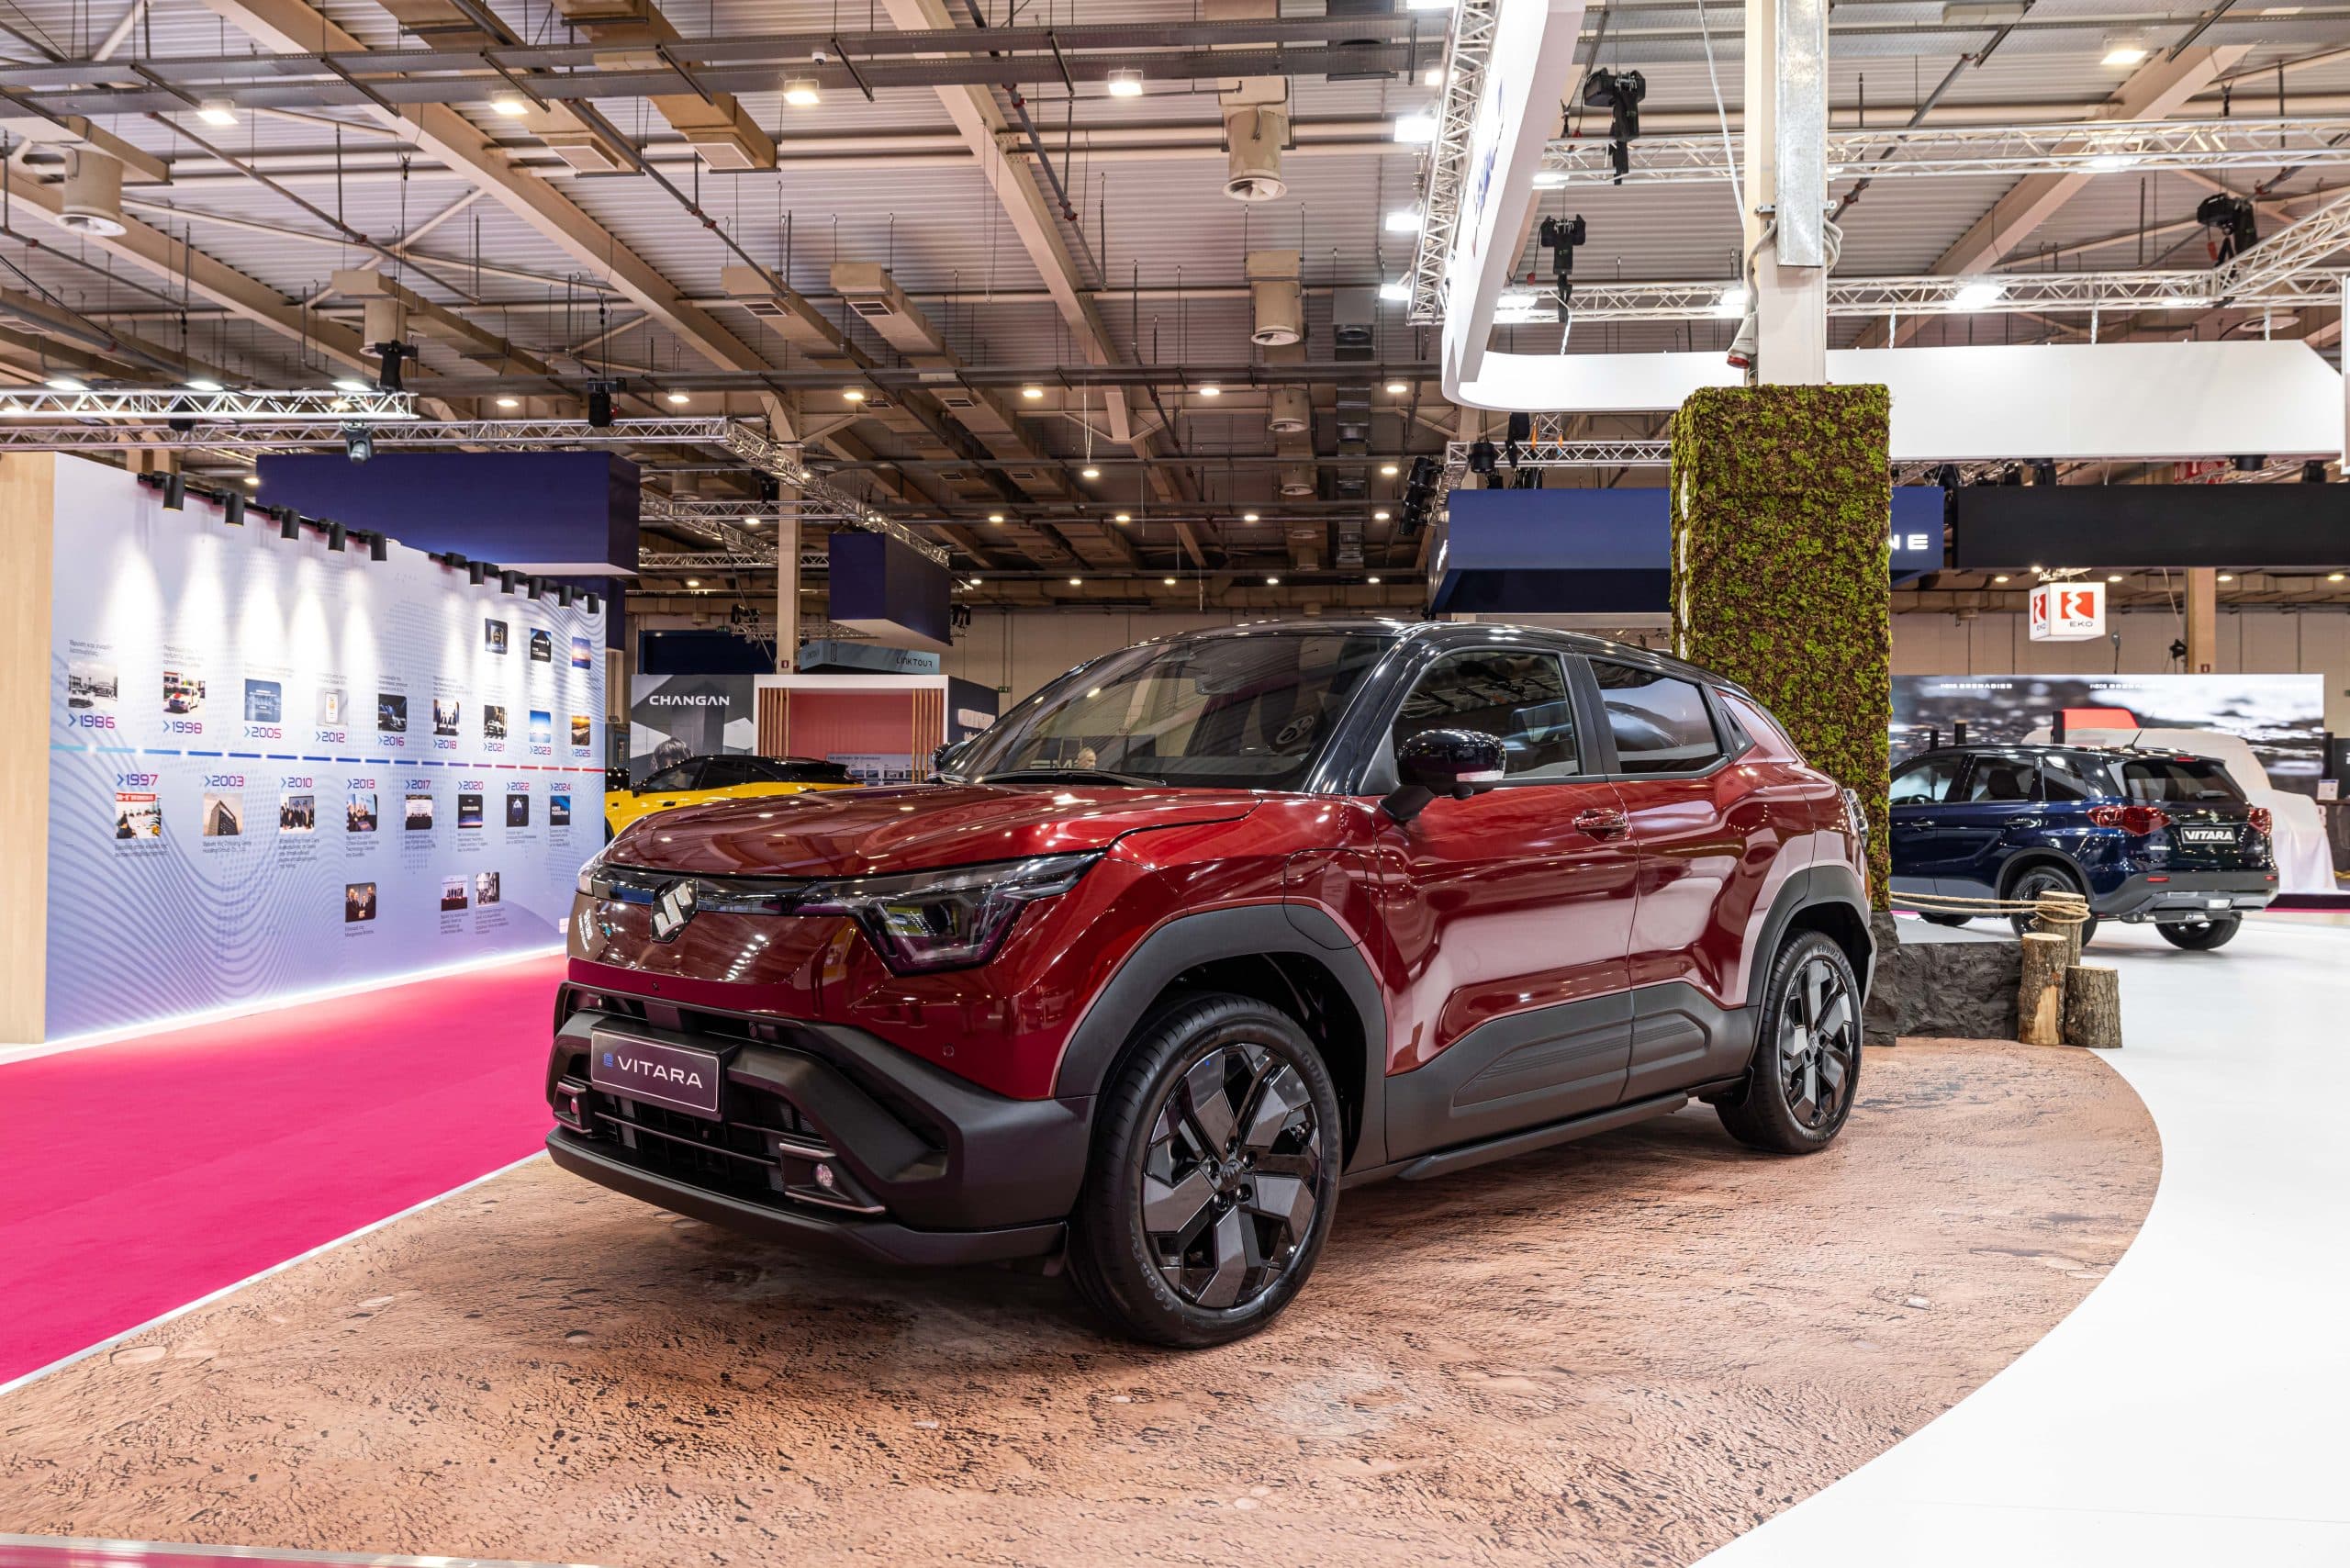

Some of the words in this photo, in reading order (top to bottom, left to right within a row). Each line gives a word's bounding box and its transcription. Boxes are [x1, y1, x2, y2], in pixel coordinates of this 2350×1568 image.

[649, 695, 731, 706] CHANGAN
[79, 714, 116, 729] 1986
[172, 721, 203, 734] 1998
[251, 726, 282, 739] 2005
[321, 731, 345, 743] 2012
[383, 735, 405, 747] 2016
[438, 739, 457, 750] 2018
[487, 742, 505, 752] 2021
[533, 745, 552, 756] 2023
[575, 748, 591, 757] 2025
[126, 773, 159, 787] 1997
[212, 775, 244, 787] 2003
[287, 777, 313, 789] 2010
[353, 778, 375, 790] 2013
[410, 779, 431, 790] 2017
[463, 780, 484, 790] 2020
[510, 781, 530, 791] 2022
[554, 782, 571, 791] 2024
[2185, 830, 2233, 841] VITARA
[618, 1055, 703, 1089] VITARA
